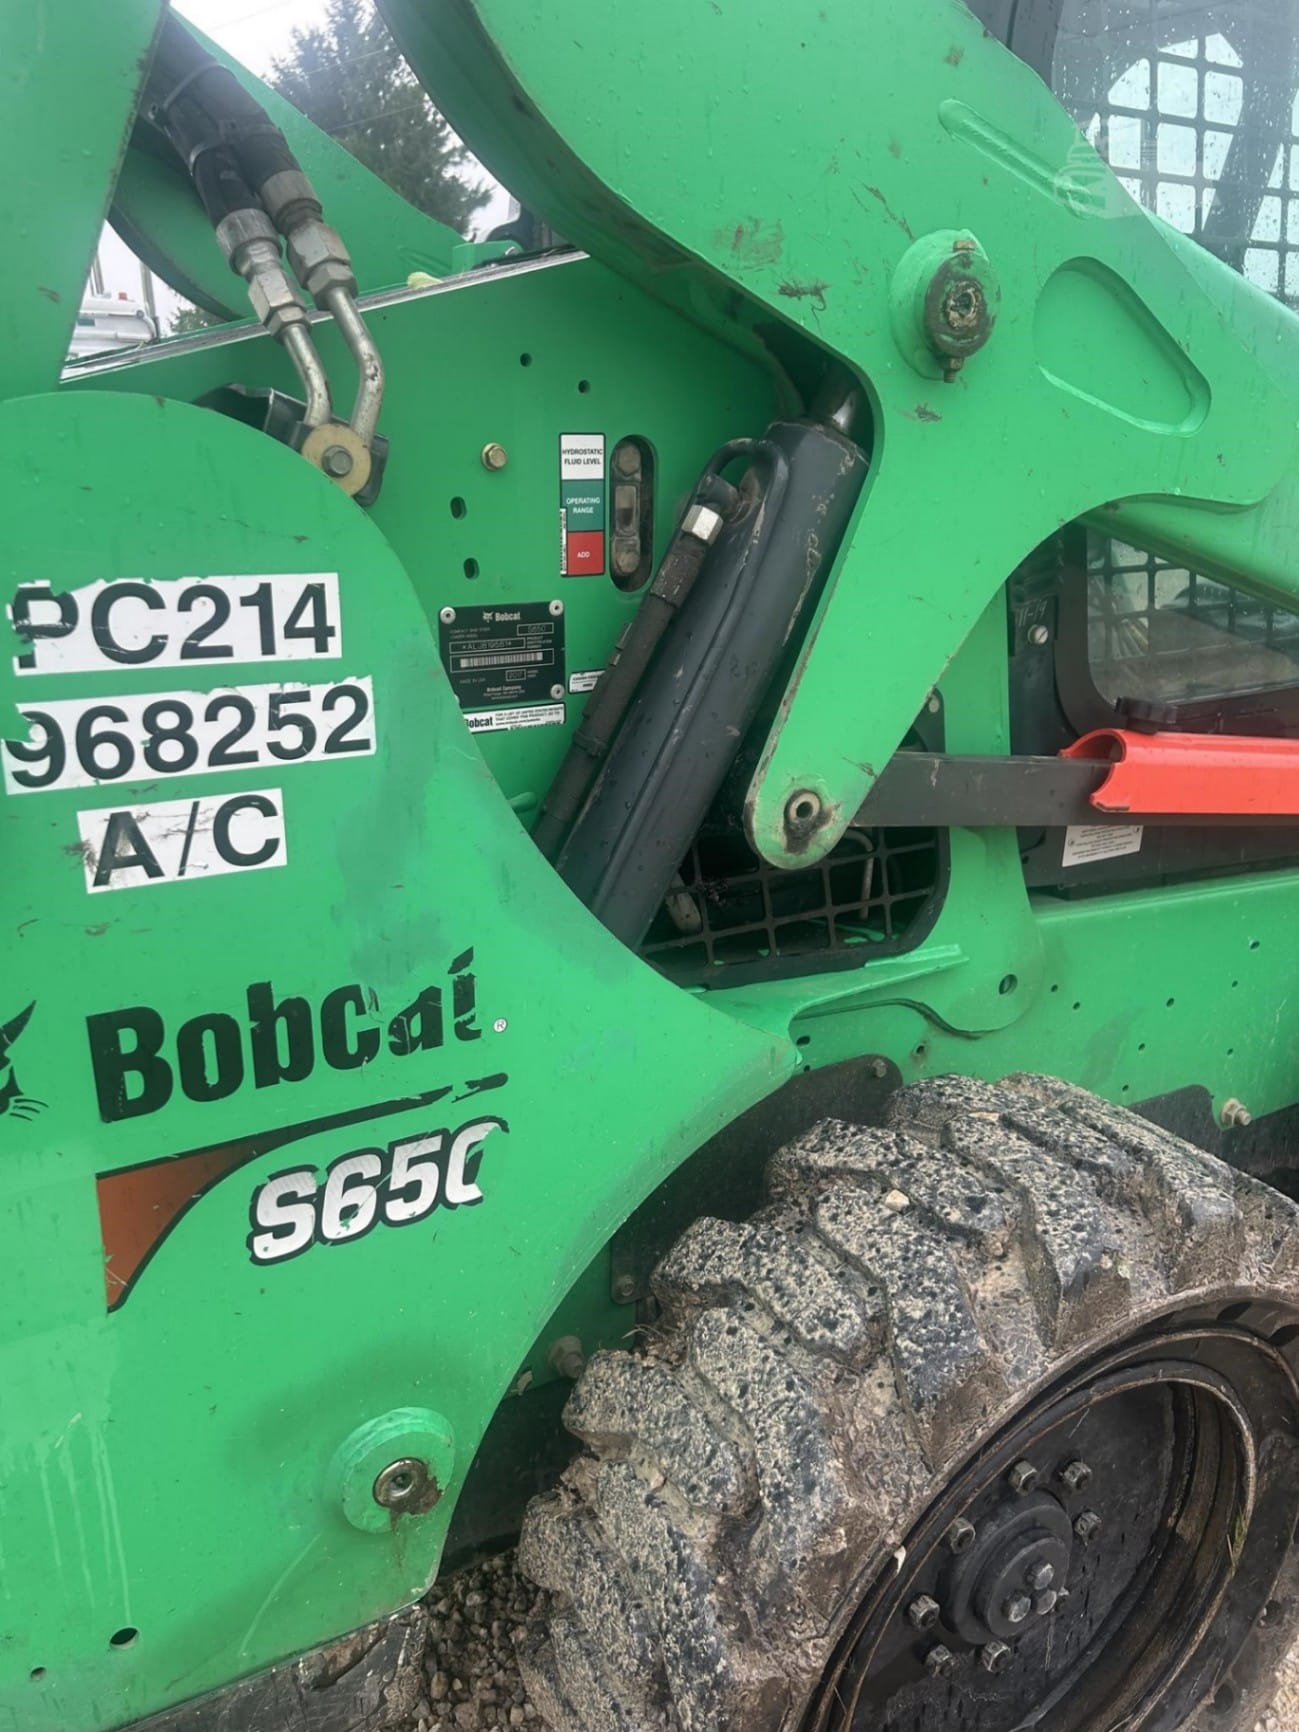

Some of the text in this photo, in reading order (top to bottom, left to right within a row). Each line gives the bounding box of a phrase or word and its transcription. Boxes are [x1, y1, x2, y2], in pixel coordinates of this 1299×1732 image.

[562, 448, 603, 456] HYDROSTATIC
[564, 457, 601, 465] FLUID LEVEL
[566, 497, 601, 505] OPERATING
[572, 506, 594, 514] RANGE
[576, 551, 591, 559] ADD
[495, 611, 521, 621] Bobcat
[12, 582, 336, 669] PC214
[5, 684, 371, 788] 968252
[92, 793, 281, 888] A/C
[86, 946, 482, 1122] Bobcat
